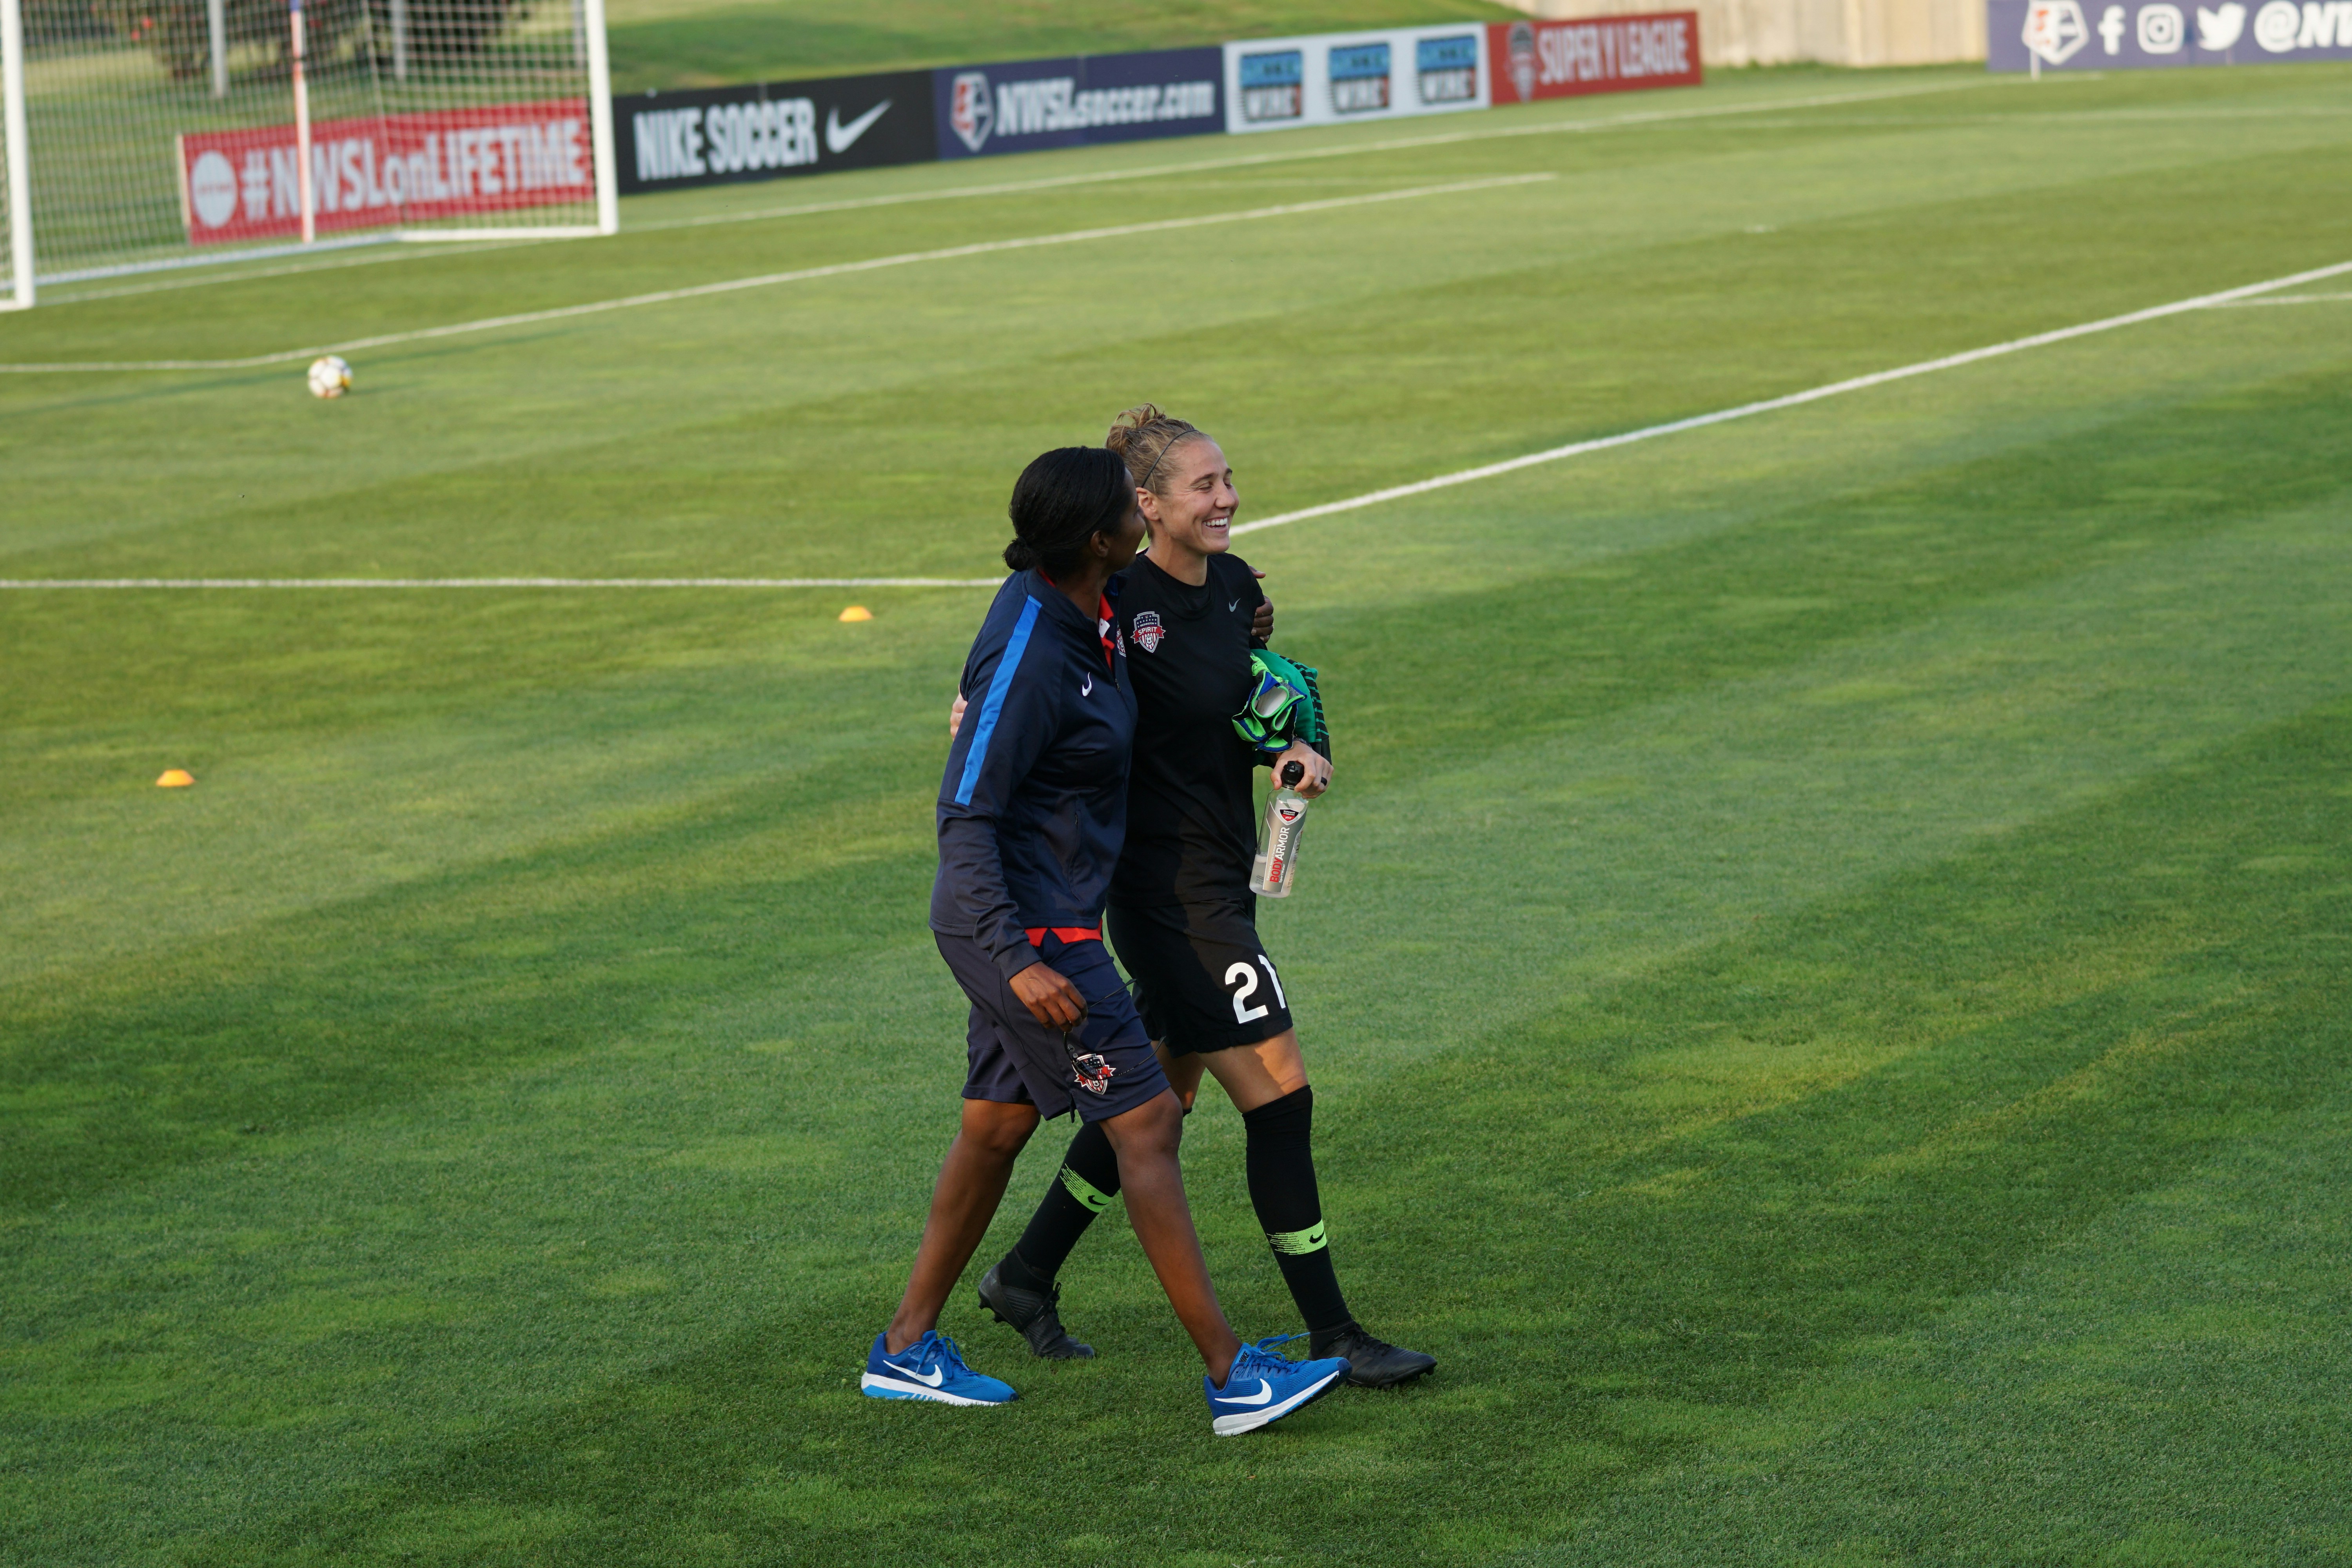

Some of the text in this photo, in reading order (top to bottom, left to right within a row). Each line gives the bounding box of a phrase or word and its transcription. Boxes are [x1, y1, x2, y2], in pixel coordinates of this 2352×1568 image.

[1538, 24, 1601, 85] SUPER
[1617, 18, 1690, 78] LEAGUE
[996, 78, 1215, 136] NWSLsoccer.com
[241, 117, 585, 222] #NWSLonLIFETIME
[633, 97, 818, 181] NIKE SOCCER
[1138, 626, 1157, 635] SPIRIT
[1270, 827, 1290, 882] BODYARMOR
[1225, 955, 1286, 1024] 21
[1239, 1350, 1249, 1362] NIKE
